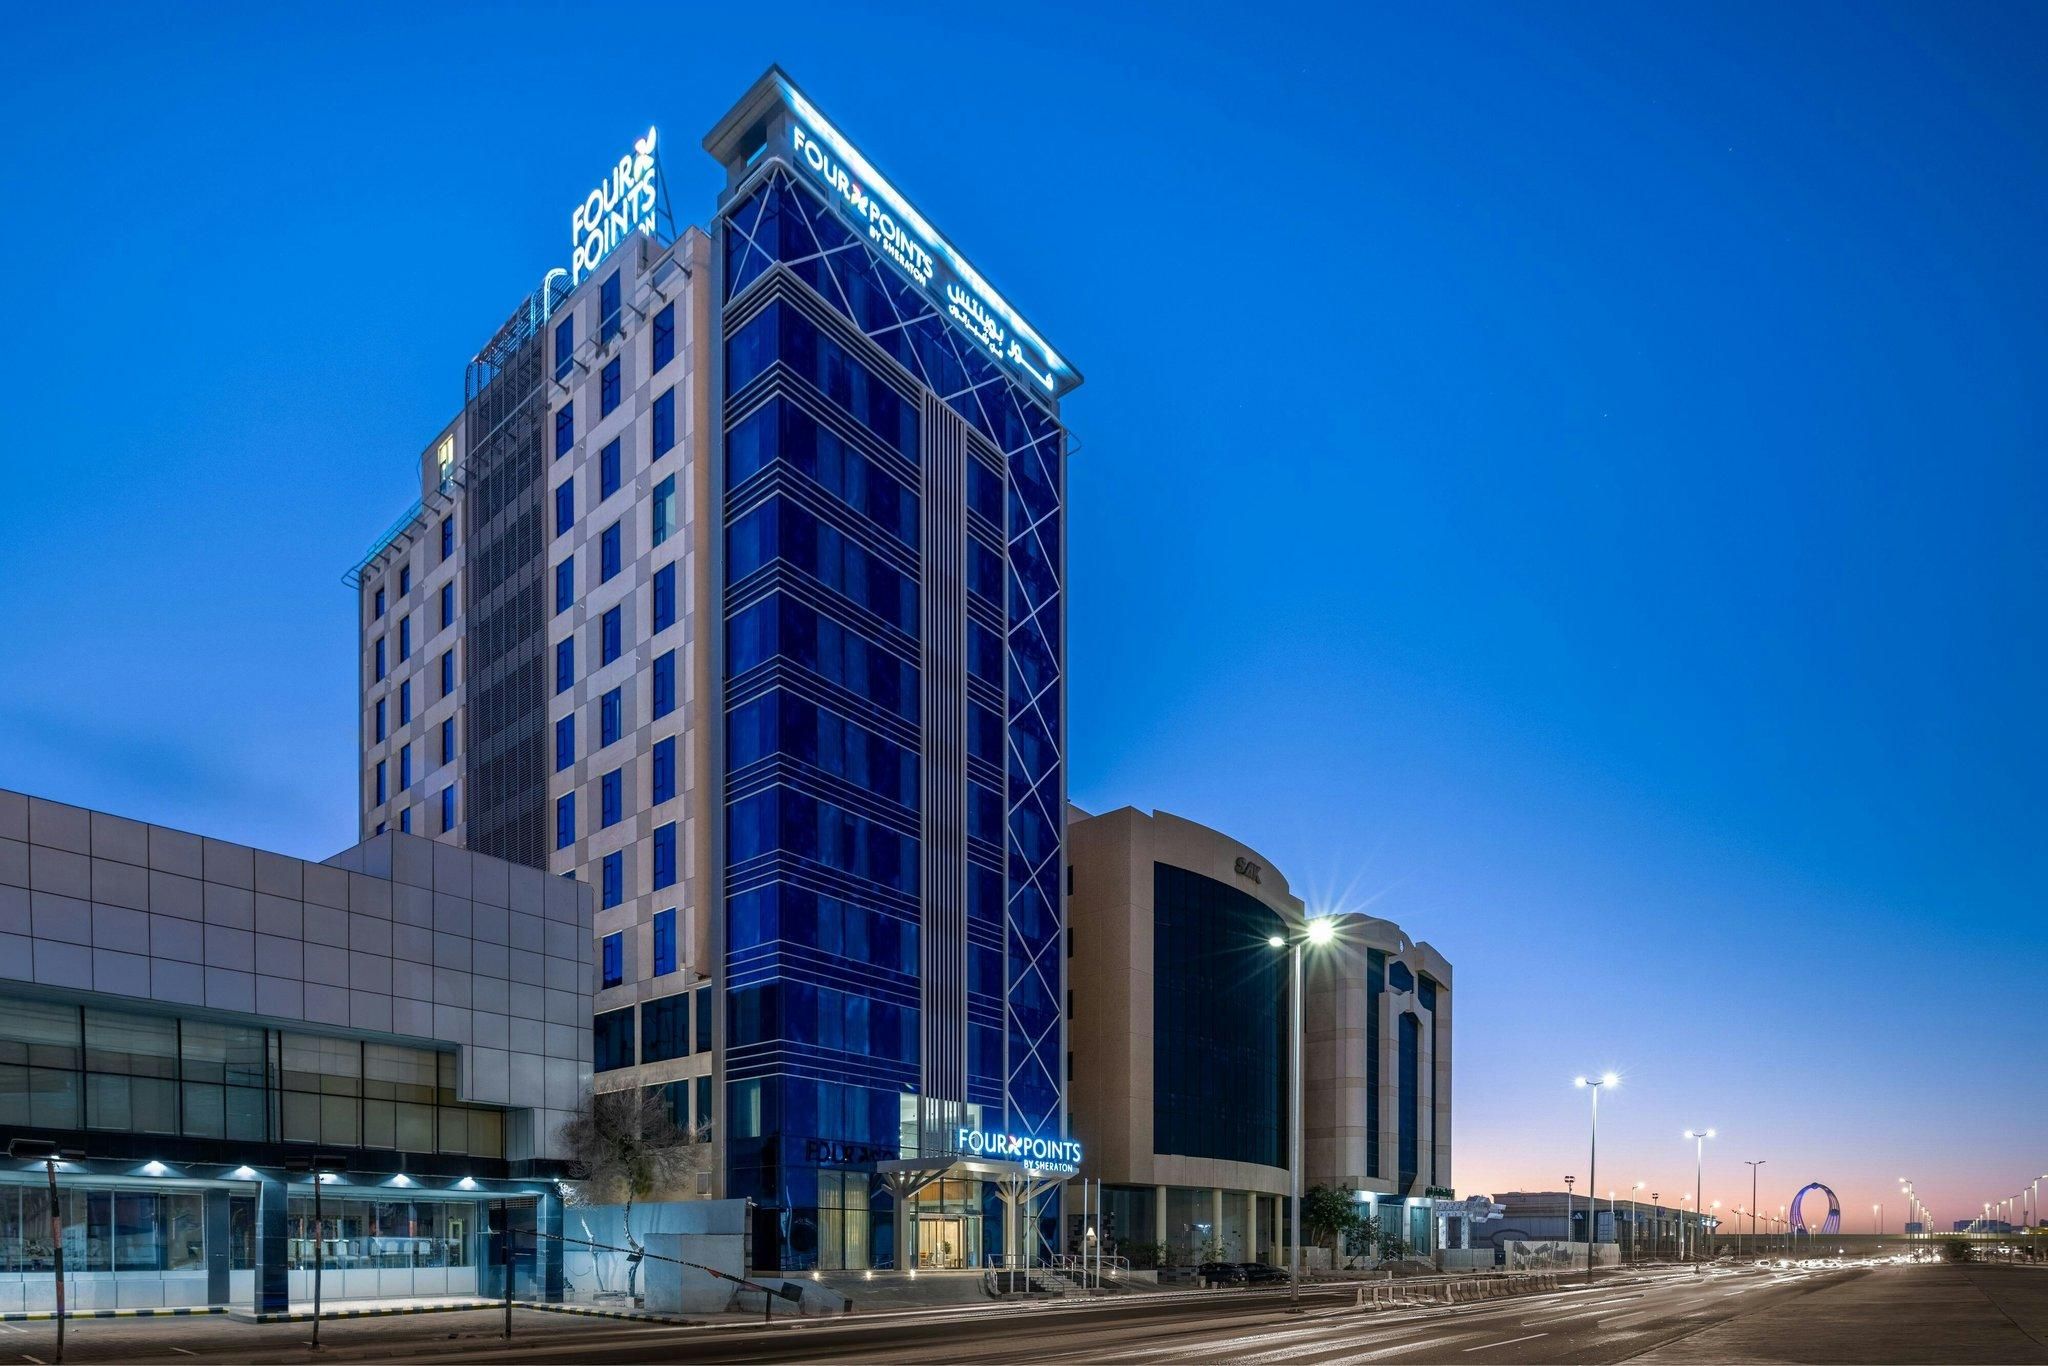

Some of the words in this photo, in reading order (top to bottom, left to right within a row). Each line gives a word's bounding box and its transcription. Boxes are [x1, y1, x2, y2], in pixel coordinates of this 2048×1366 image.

[572, 154, 634, 247] FOUR
[572, 167, 656, 286] POINTS
[793, 126, 850, 199] FOUR
[869, 200, 933, 279] POINTS
[869, 225, 881, 242] BY
[882, 238, 927, 288] SHERATON
[959, 1128, 1008, 1154] FOUR
[1023, 1136, 1081, 1162] POINTS
[1023, 1159, 1033, 1169] BY
[1035, 1160, 1073, 1173] SHERATON
